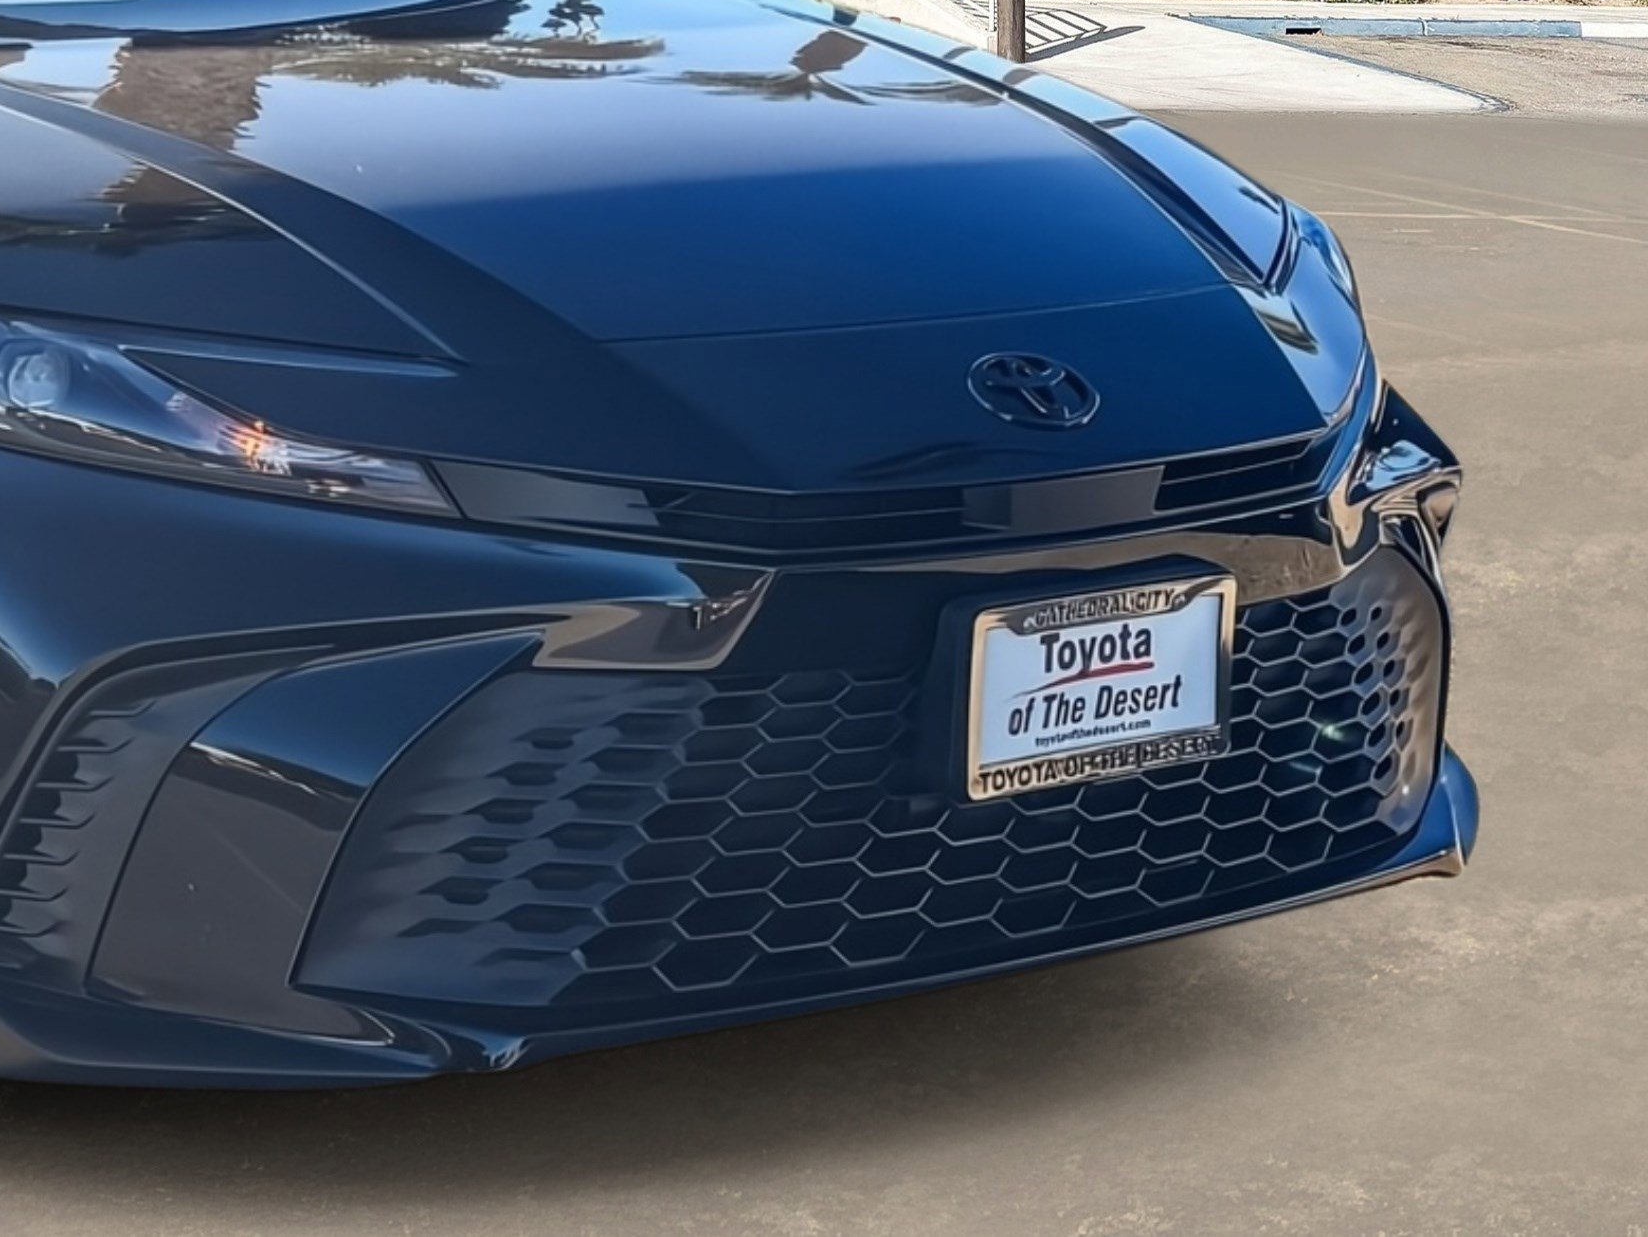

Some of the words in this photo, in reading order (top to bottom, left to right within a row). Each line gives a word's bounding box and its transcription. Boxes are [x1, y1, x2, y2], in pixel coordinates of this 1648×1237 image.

[1133, 588, 1175, 612] CITY
[1040, 623, 1152, 674] Toyota
[1008, 697, 1037, 736] of
[1042, 692, 1086, 729] The
[1094, 674, 1183, 720] Desert
[979, 761, 1058, 794] TOYOTA
